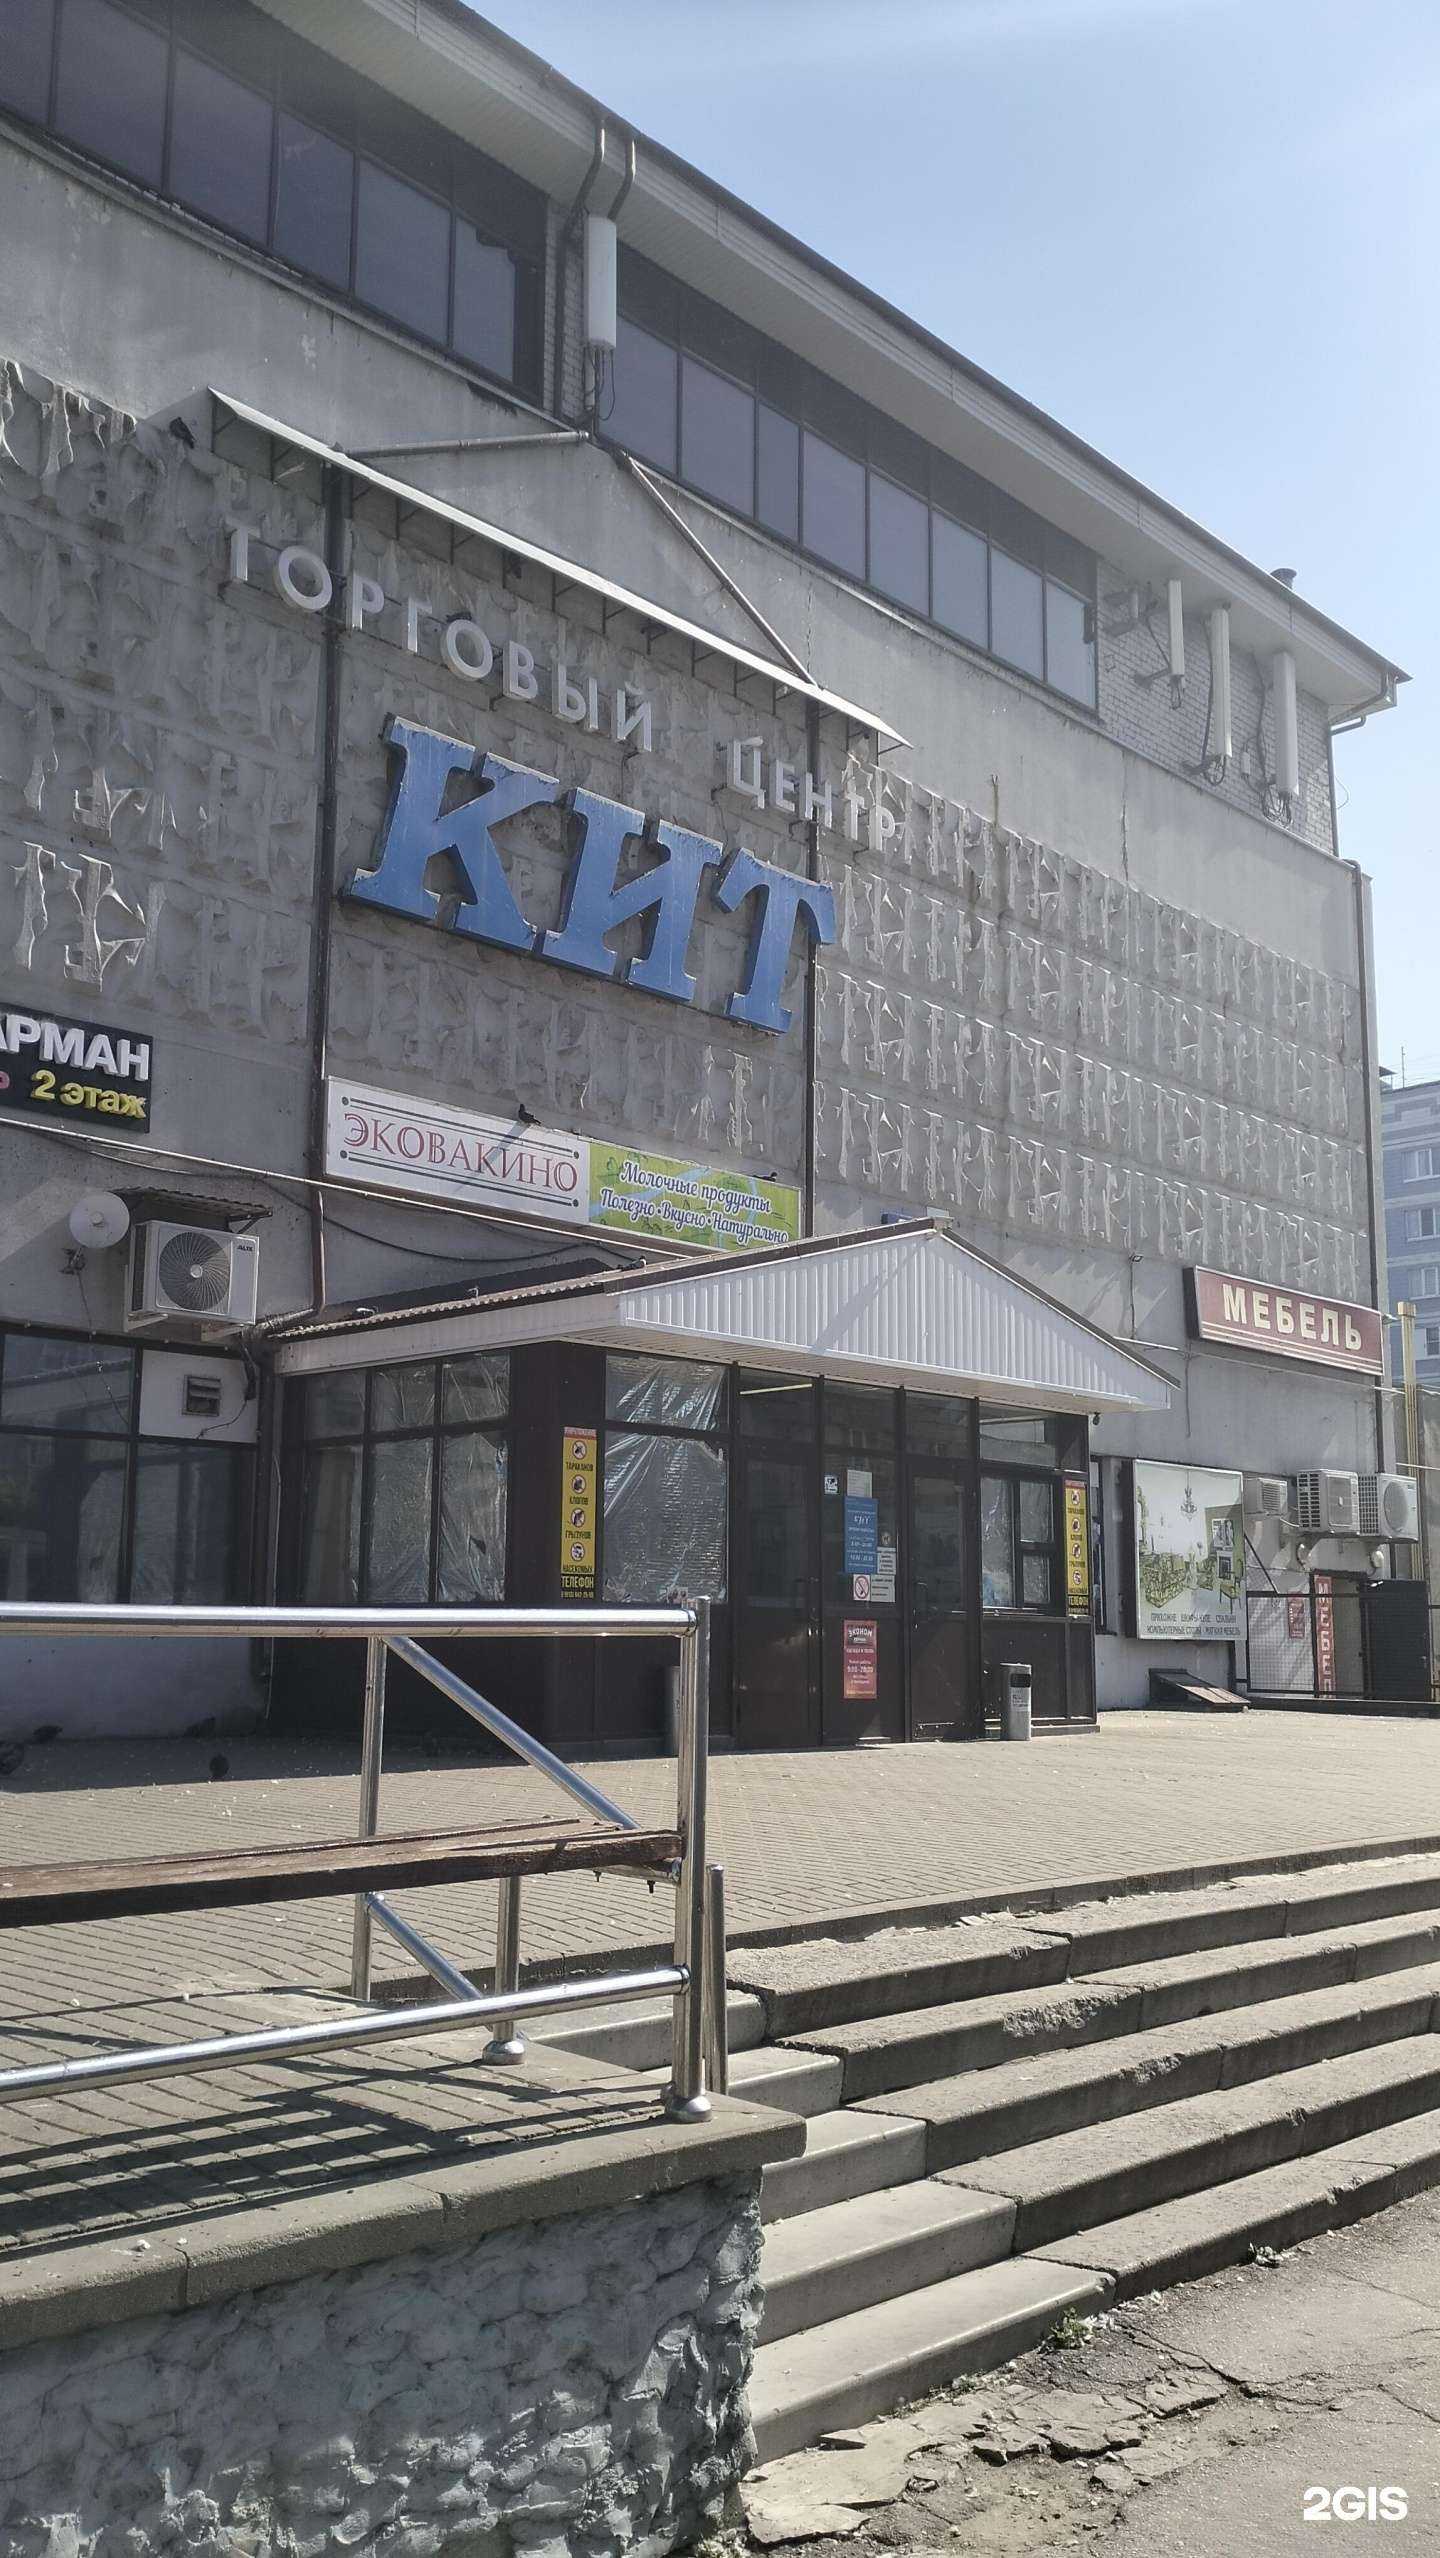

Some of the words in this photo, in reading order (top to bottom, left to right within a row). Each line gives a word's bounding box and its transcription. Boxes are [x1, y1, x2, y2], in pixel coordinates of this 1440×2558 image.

[224, 517, 653, 752] ТОРГОВЫЙ
[723, 735, 897, 852] ЦЕНТР
[347, 713, 837, 1035] КИТ
[0, 1013, 150, 1081] РМАН
[31, 1069, 56, 1100] 2
[60, 1082, 147, 1118] этаж
[344, 1112, 578, 1192] ЭКОВАКИНО
[600, 1188, 655, 1222] Полезно
[660, 1202, 705, 1230] Вкусно
[711, 1211, 789, 1246] Натурально
[620, 1161, 698, 1196] Молочные
[701, 1185, 771, 1214] продукты
[1221, 1282, 1363, 1351] МЕБЕЛЬ
[561, 1576, 594, 1589] ТЕЛЕФОН
